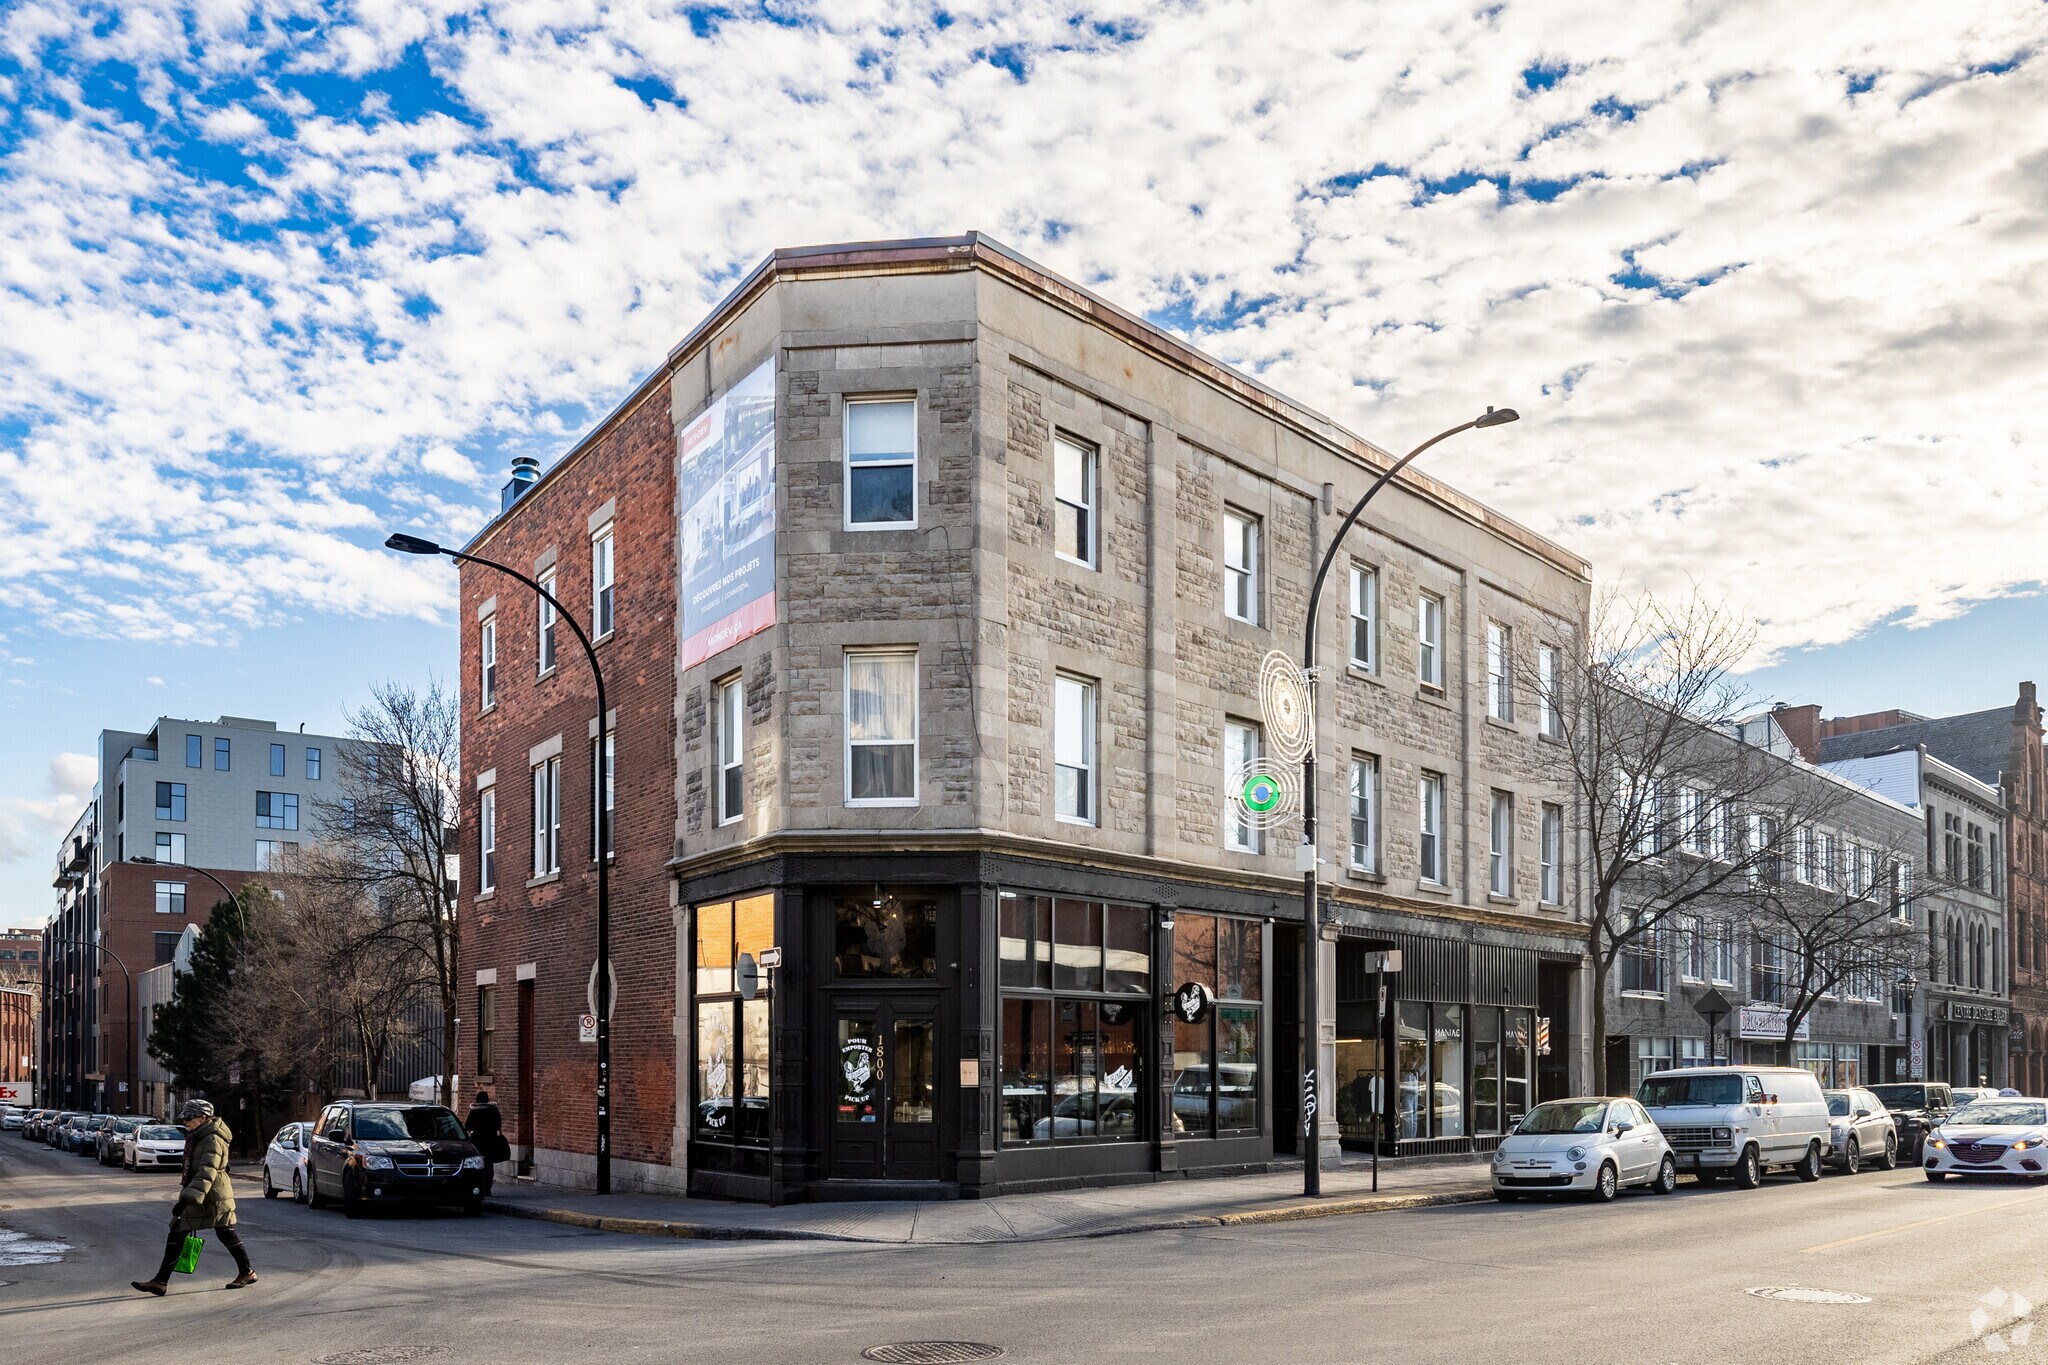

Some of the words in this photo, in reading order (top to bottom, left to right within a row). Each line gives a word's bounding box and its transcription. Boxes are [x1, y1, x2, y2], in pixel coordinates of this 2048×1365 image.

[687, 423, 708, 446] MONDEV
[692, 579, 722, 605] DÉCOUVREZ
[722, 572, 734, 587] NOS
[734, 557, 760, 580] PROJETS
[707, 619, 742, 646] MONDEV.CA
[1434, 1028, 1460, 1038] MANIAC
[841, 1045, 873, 1053] EMPORTER
[876, 1034, 884, 1080] 1800
[844, 1094, 860, 1103] PICK
[860, 1094, 870, 1102] UP
[705, 1113, 719, 1127] PICK
[718, 1114, 726, 1127] UP
